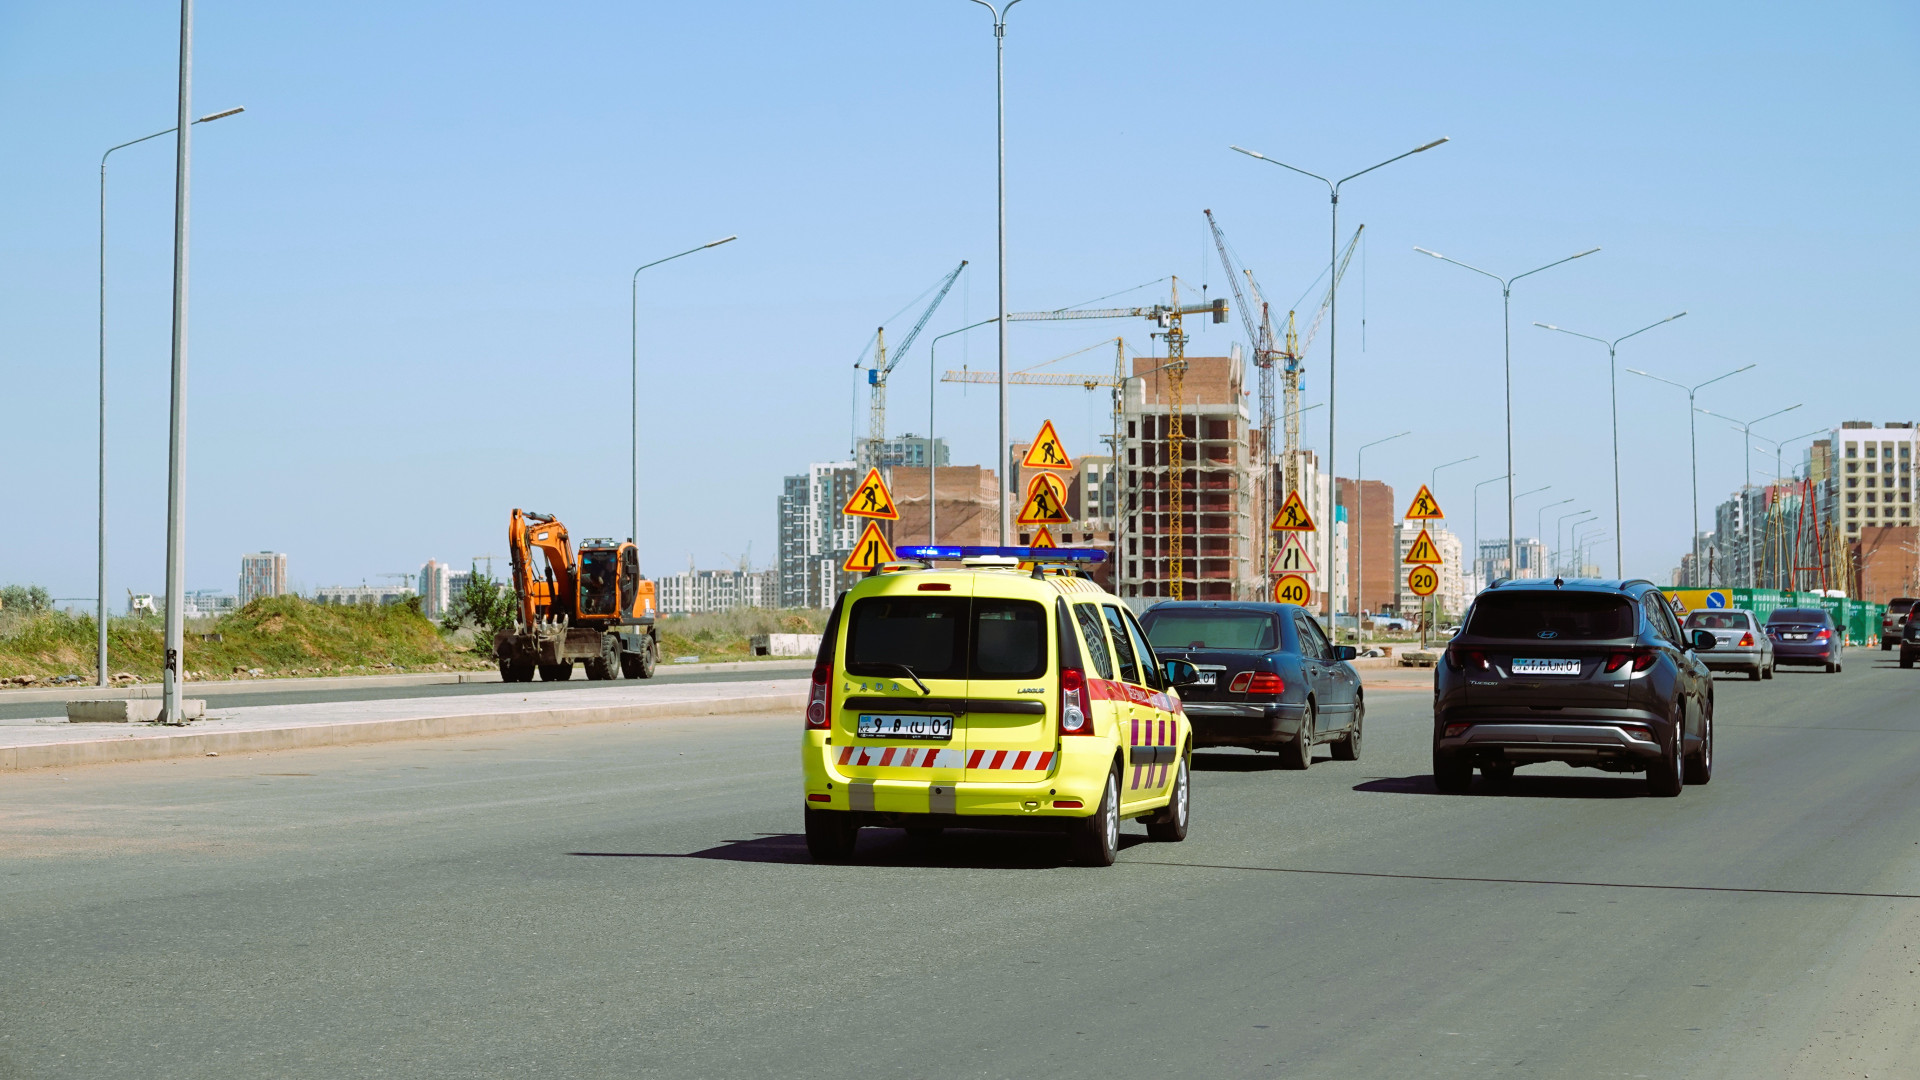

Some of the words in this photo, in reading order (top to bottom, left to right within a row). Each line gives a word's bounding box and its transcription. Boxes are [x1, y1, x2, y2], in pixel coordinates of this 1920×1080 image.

[1414, 574, 1432, 588] 20
[1281, 585, 1303, 601] 40
[1566, 660, 1580, 671] 01
[1203, 673, 1216, 684] 01
[844, 682, 900, 692] LADA
[932, 719, 952, 735] 01
